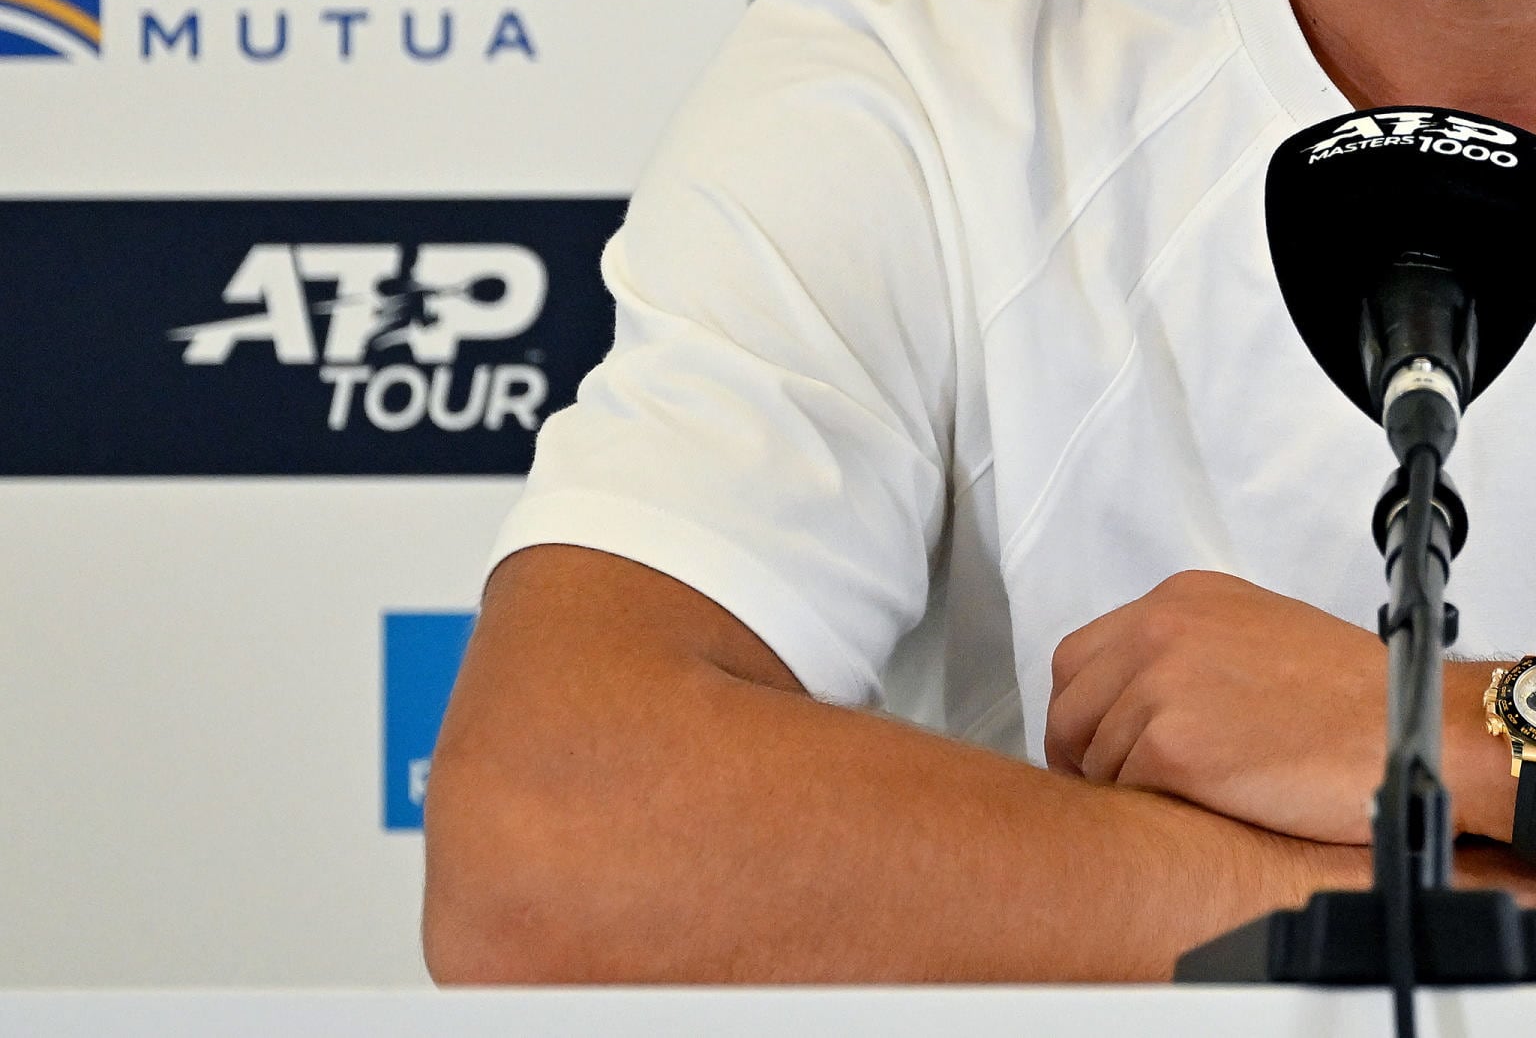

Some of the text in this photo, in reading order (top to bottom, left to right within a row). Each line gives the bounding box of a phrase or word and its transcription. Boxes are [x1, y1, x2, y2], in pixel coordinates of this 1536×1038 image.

[141, 10, 536, 61] MUTUA
[1301, 112, 1517, 153] ATP
[1308, 136, 1519, 168] MASTERS 1000
[168, 242, 549, 365] ATP
[319, 364, 549, 432] TOUR
